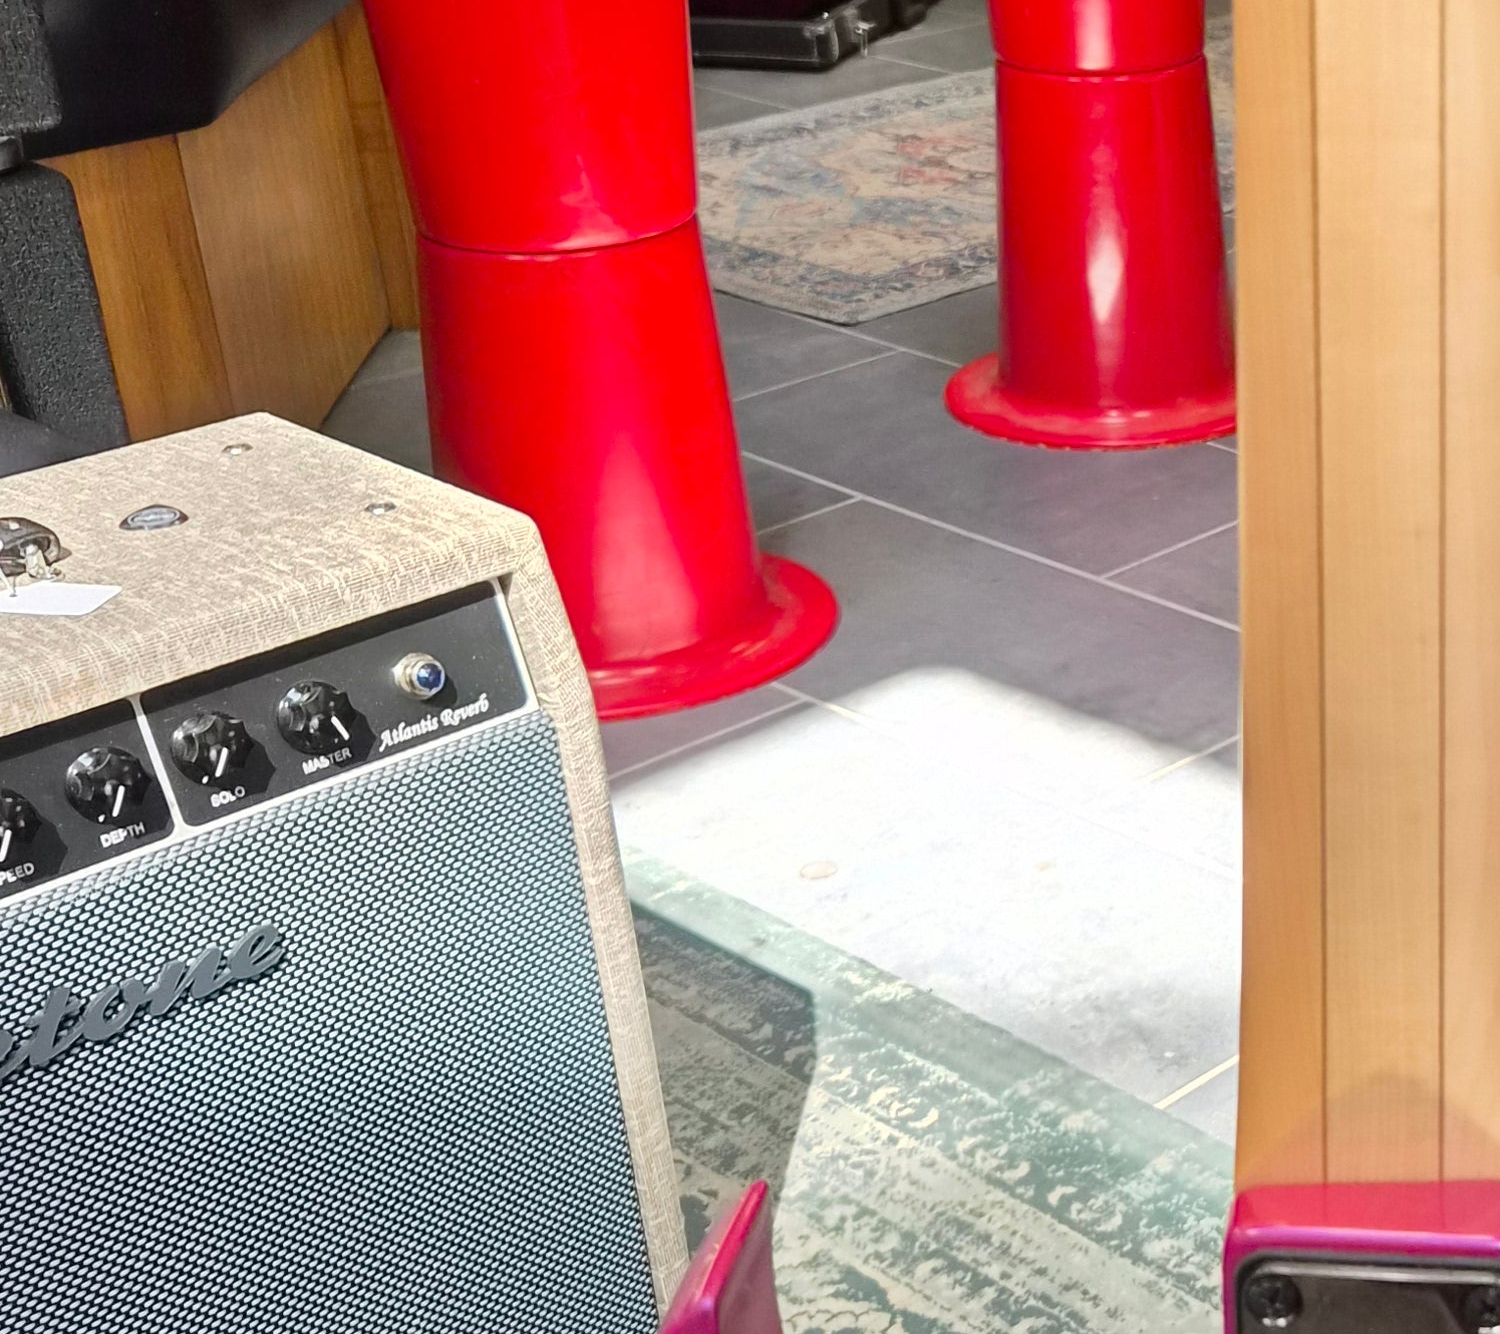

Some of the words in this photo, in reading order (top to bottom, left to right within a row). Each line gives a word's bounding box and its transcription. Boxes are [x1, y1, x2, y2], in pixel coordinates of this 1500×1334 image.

[379, 714, 439, 752] Atlantis
[439, 692, 490, 727] Reverb
[302, 748, 352, 775] MASTER
[210, 785, 246, 808] SOLO
[99, 821, 146, 849] DEPTH
